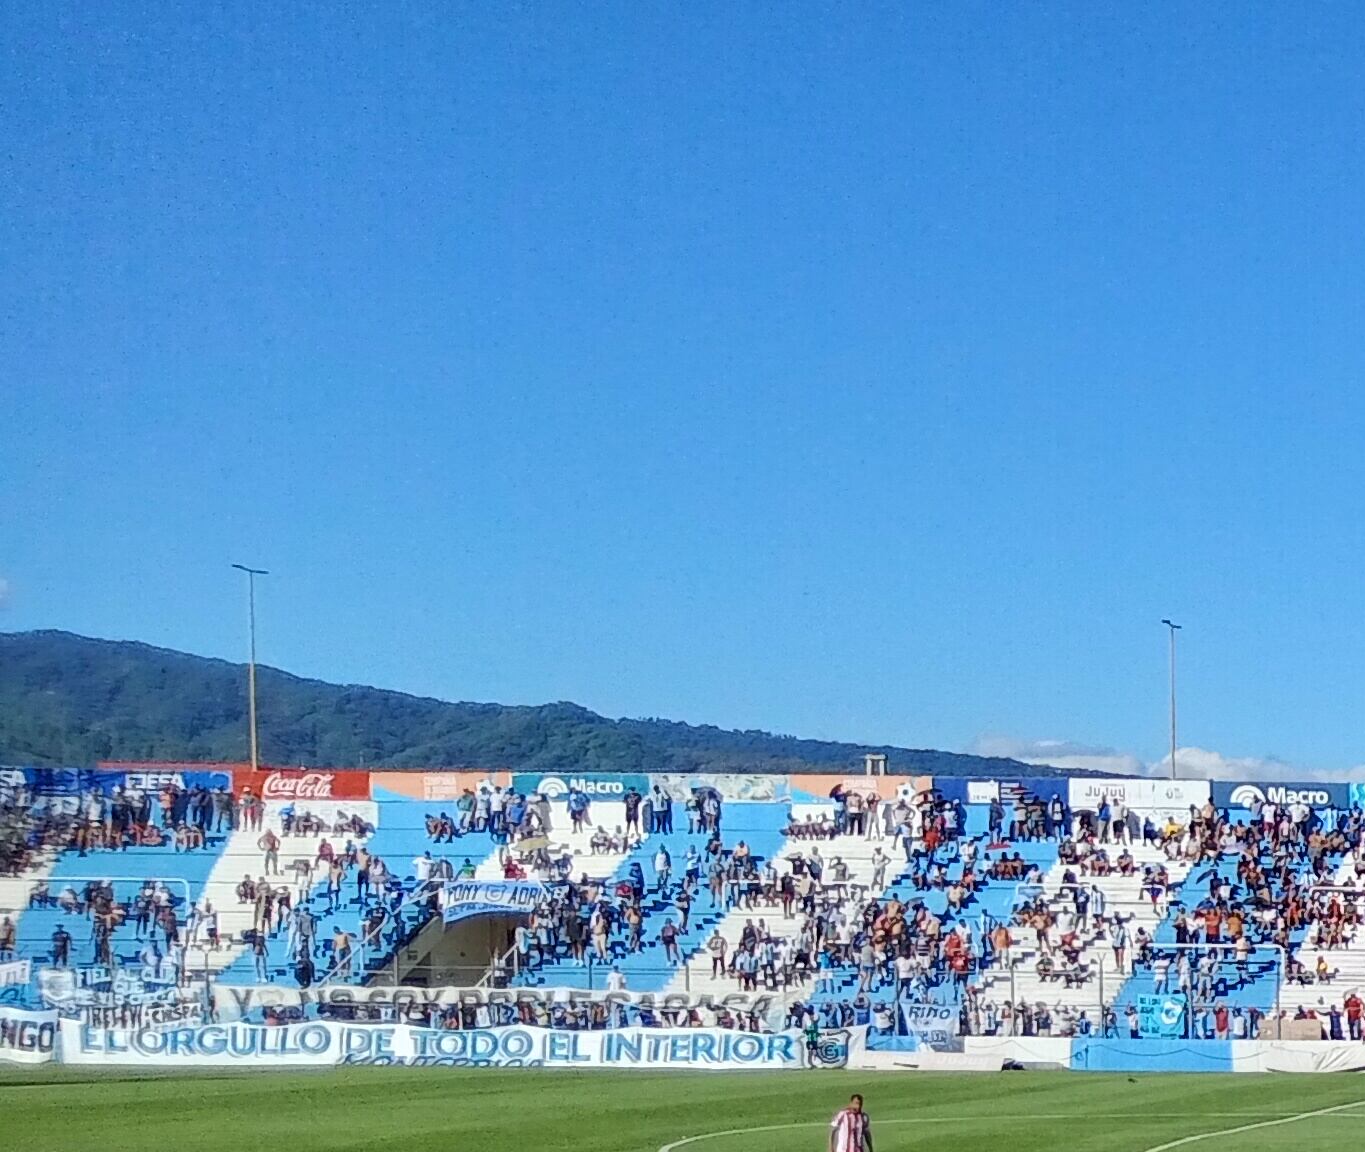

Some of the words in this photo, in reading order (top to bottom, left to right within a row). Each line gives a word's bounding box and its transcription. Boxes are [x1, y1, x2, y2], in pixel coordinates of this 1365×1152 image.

[1268, 787, 1329, 804] Macro
[80, 1024, 128, 1054] EL
[133, 1025, 332, 1058] ORGULLO
[342, 1028, 393, 1058] DE
[410, 1029, 534, 1059] TODO
[547, 1032, 591, 1062] EL
[604, 1032, 796, 1063] INTERIOR
